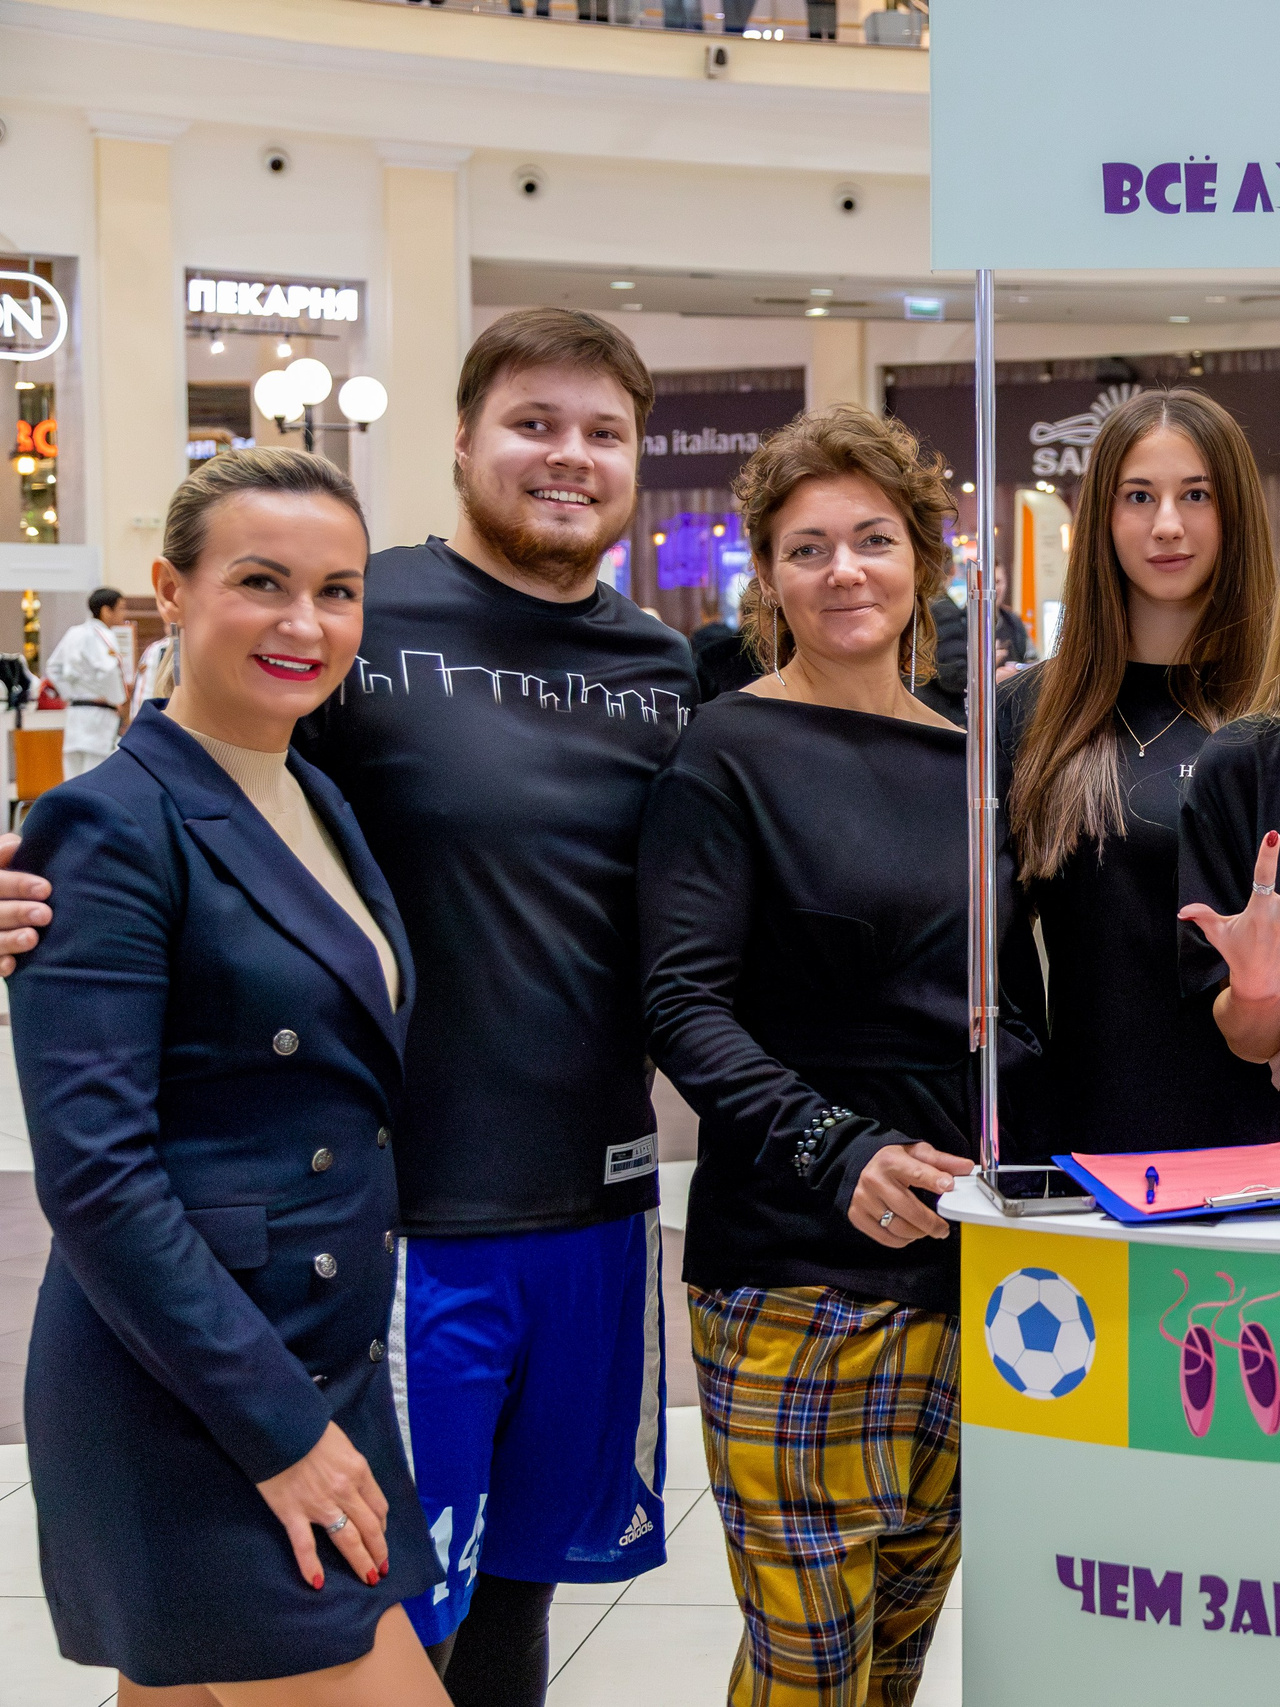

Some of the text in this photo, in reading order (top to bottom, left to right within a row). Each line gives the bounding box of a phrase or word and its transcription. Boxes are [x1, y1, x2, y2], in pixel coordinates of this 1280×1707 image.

[1101, 154, 1219, 216] ВСЁ
[0, 293, 44, 340] N
[188, 278, 358, 322] ПЕКАРНЯ
[671, 426, 760, 456] italiana
[618, 1520, 654, 1547] adidas
[1054, 1554, 1184, 1628] ЧЕМ
